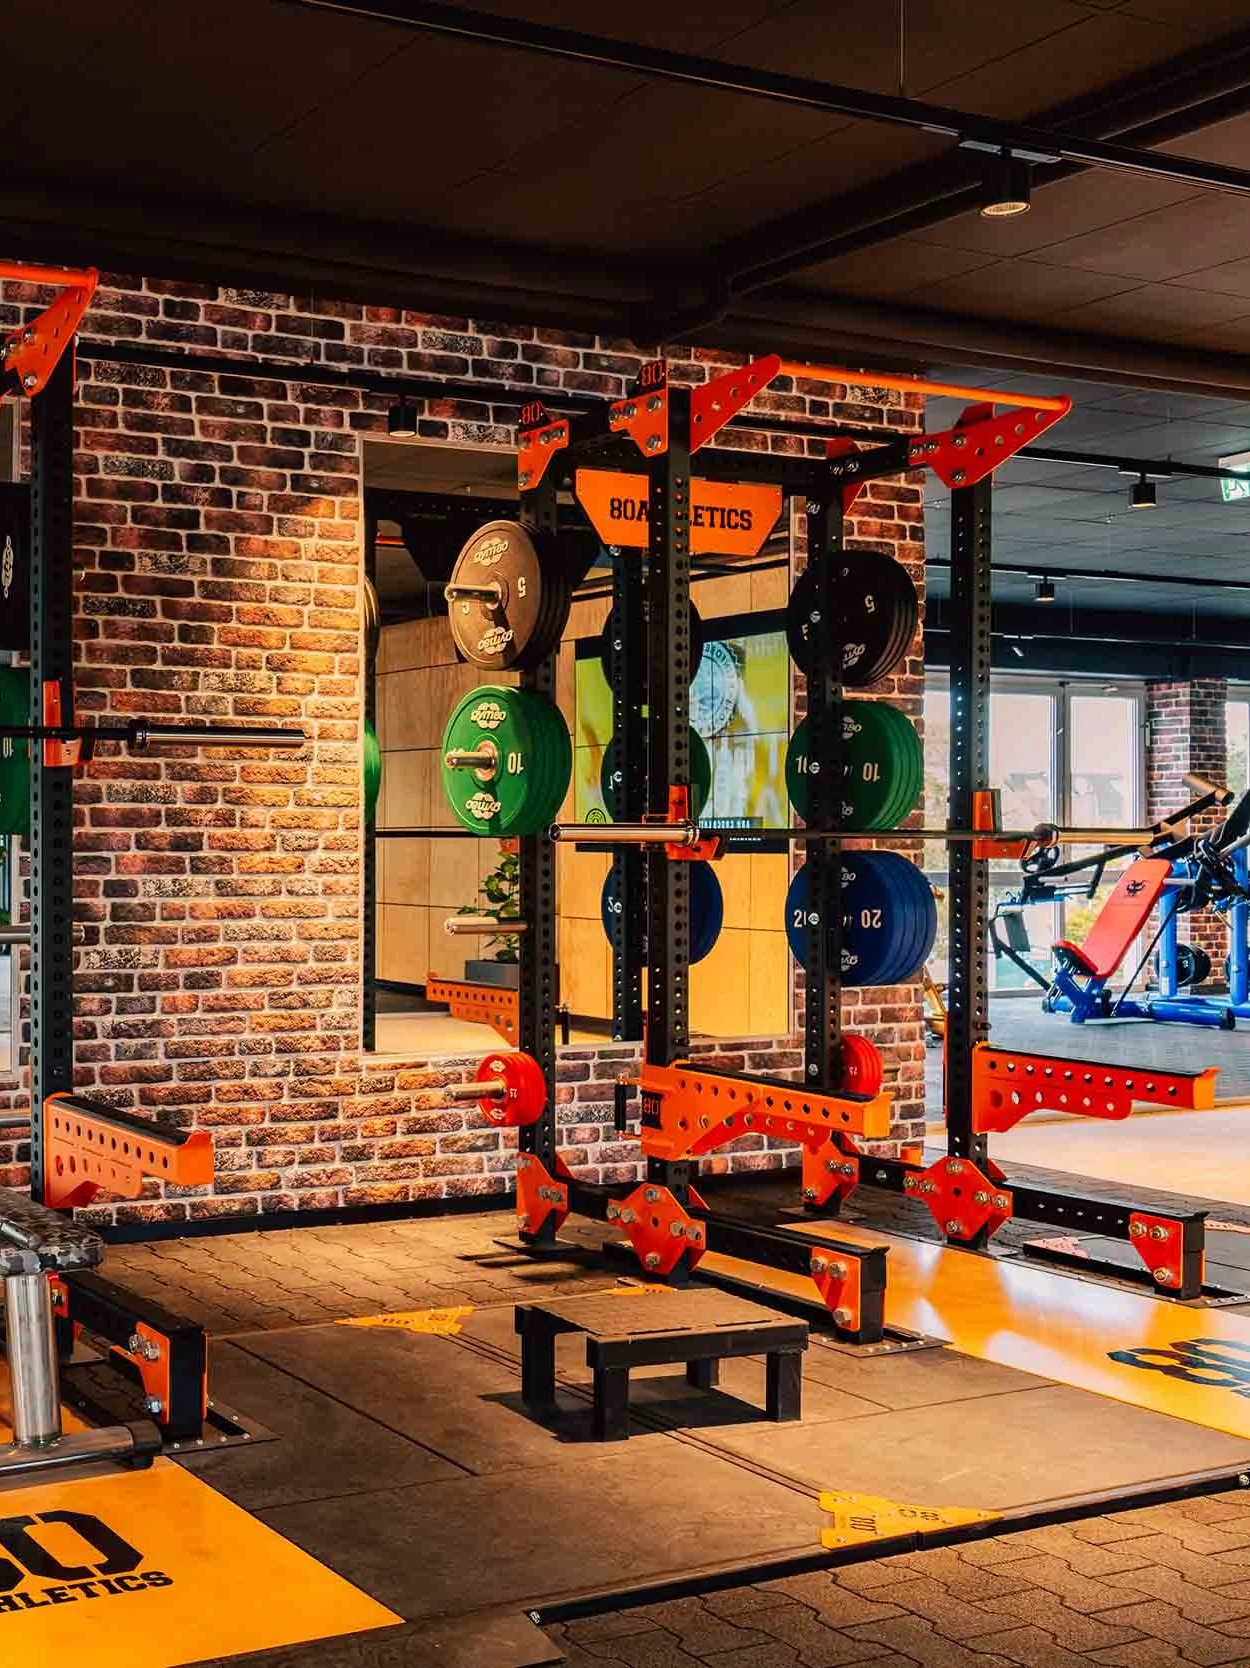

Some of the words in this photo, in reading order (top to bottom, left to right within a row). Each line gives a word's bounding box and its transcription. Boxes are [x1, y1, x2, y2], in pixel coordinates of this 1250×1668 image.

[641, 362, 663, 387] 80
[609, 498, 753, 531] 80AETICS
[517, 577, 527, 598] 5
[864, 594, 876, 613] 5
[507, 752, 524, 774] 10
[862, 762, 881, 782] 10
[860, 909, 882, 929] 20
[644, 1097, 659, 1115] 80
